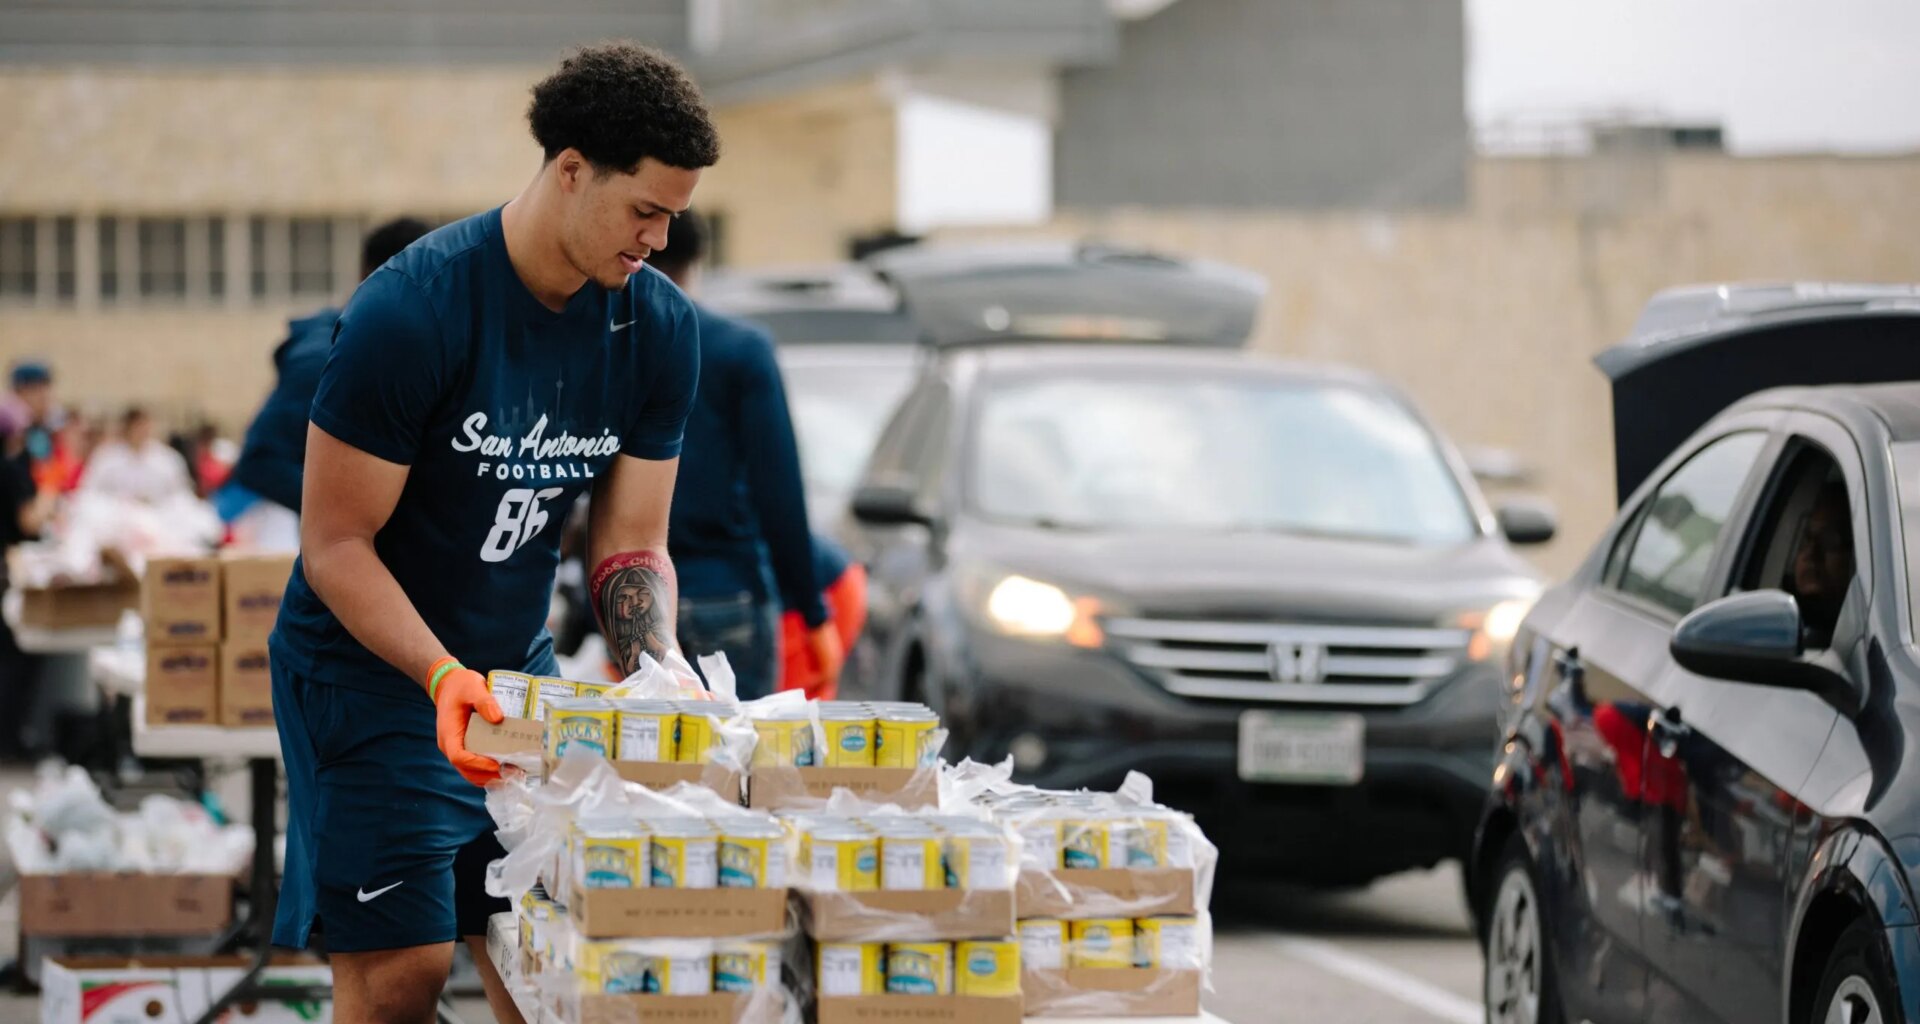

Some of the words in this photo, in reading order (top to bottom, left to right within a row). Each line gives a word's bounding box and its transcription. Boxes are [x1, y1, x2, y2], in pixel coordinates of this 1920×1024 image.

[451, 411, 513, 458] San
[518, 413, 621, 460] Antonio
[477, 462, 594, 480] FOOTBALL
[480, 487, 564, 562] 86
[560, 721, 603, 740] LUCK'S
